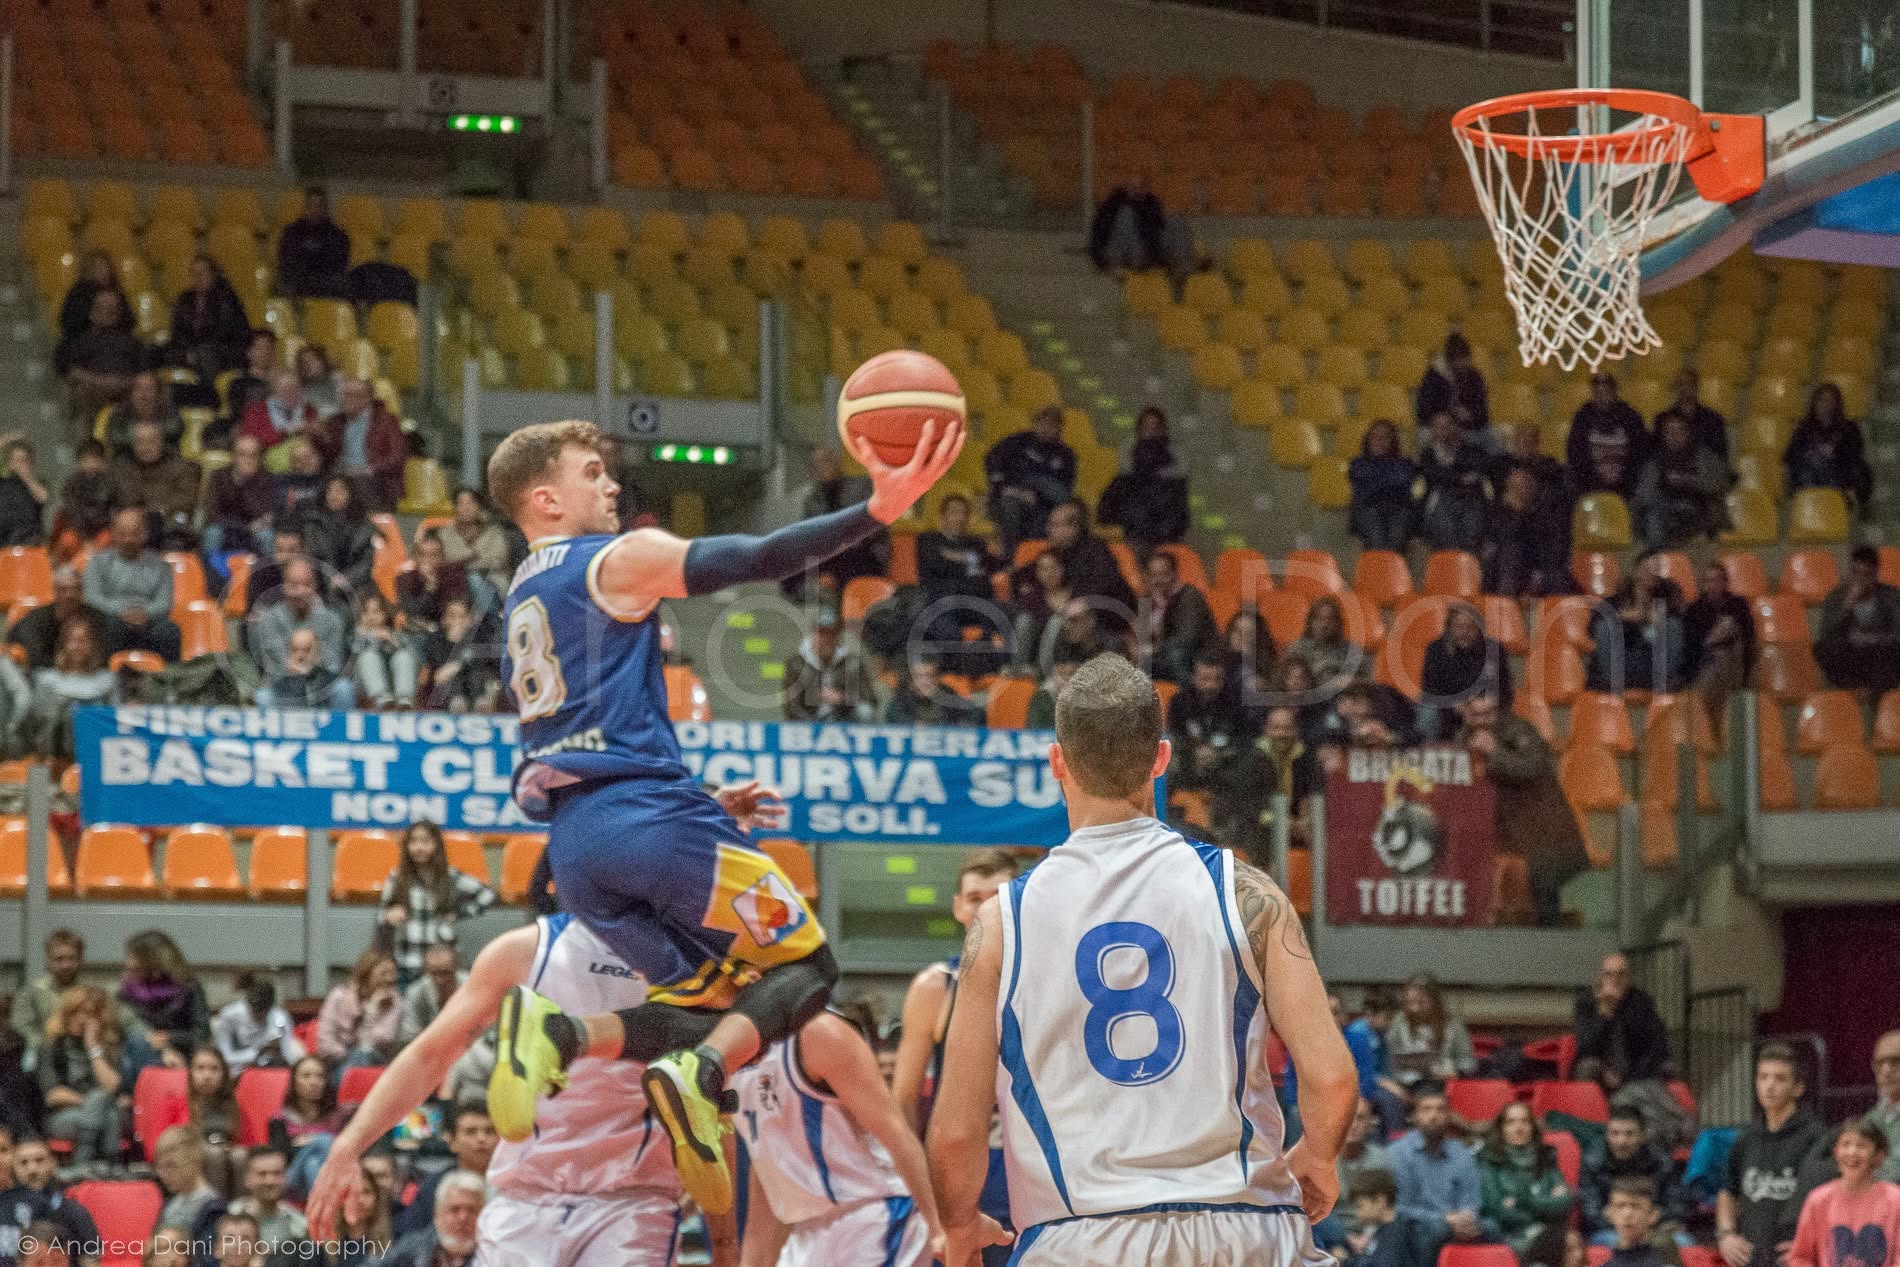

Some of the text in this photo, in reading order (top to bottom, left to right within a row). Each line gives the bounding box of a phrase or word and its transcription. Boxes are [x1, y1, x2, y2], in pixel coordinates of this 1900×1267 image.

[507, 595, 567, 724] 8
[114, 704, 332, 740] FINCHE'
[378, 712, 521, 745] NOST
[674, 719, 765, 751] ORI
[779, 722, 1058, 760] BATTERAN
[100, 736, 398, 791] BASKET
[966, 760, 1063, 809] SU
[331, 791, 448, 825] NON
[461, 794, 546, 826] SA
[807, 803, 942, 836] SOLI.
[589, 962, 639, 981] LEGE
[1074, 921, 1186, 1088] 8
